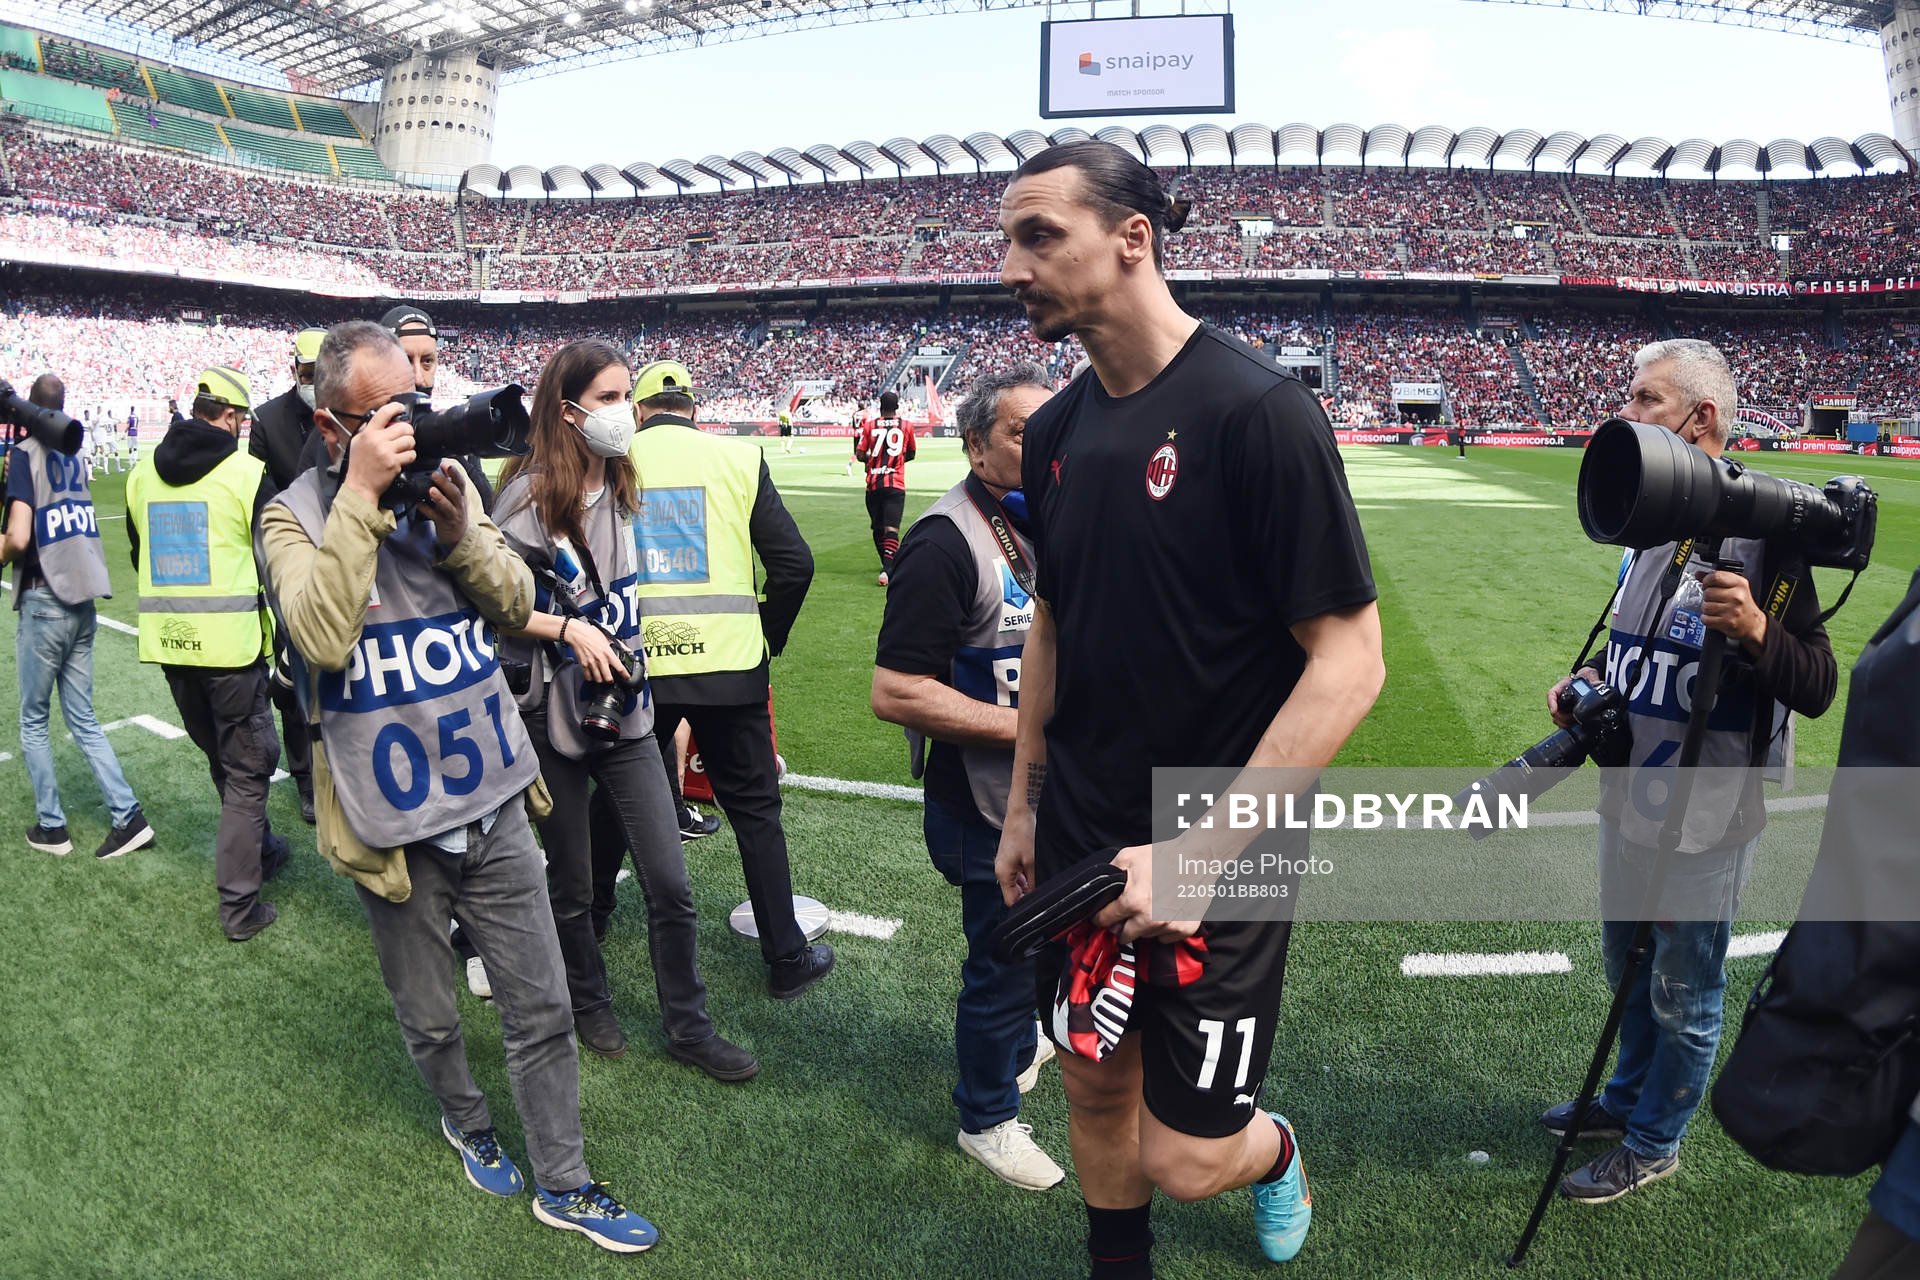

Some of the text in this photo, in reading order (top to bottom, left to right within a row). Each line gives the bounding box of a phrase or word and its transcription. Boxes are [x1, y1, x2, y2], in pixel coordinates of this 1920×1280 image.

[1105, 51, 1194, 71] snaipay
[1106, 88, 1165, 97] MATCH SPONSOR
[1679, 282, 1789, 296] MILAN ISTRA
[1810, 276, 1914, 293] FOSSA DEI
[799, 425, 819, 435] tanti
[820, 425, 846, 437] premi
[1352, 433, 1399, 443] rossoneri
[1473, 434, 1565, 445] snaipayconcorso.it
[871, 428, 905, 457] 79
[1772, 441, 1778, 449] e
[1780, 439, 1800, 449] tanti
[1802, 440, 1827, 452] premi
[45, 449, 88, 493] 02
[641, 498, 700, 527] EWARD
[991, 514, 1018, 562] Canon
[1004, 613, 1032, 627] SERIE
[1687, 615, 1699, 635] 360
[160, 637, 202, 651] WINCH
[372, 692, 515, 812] 051
[1197, 1017, 1256, 1089] 11
